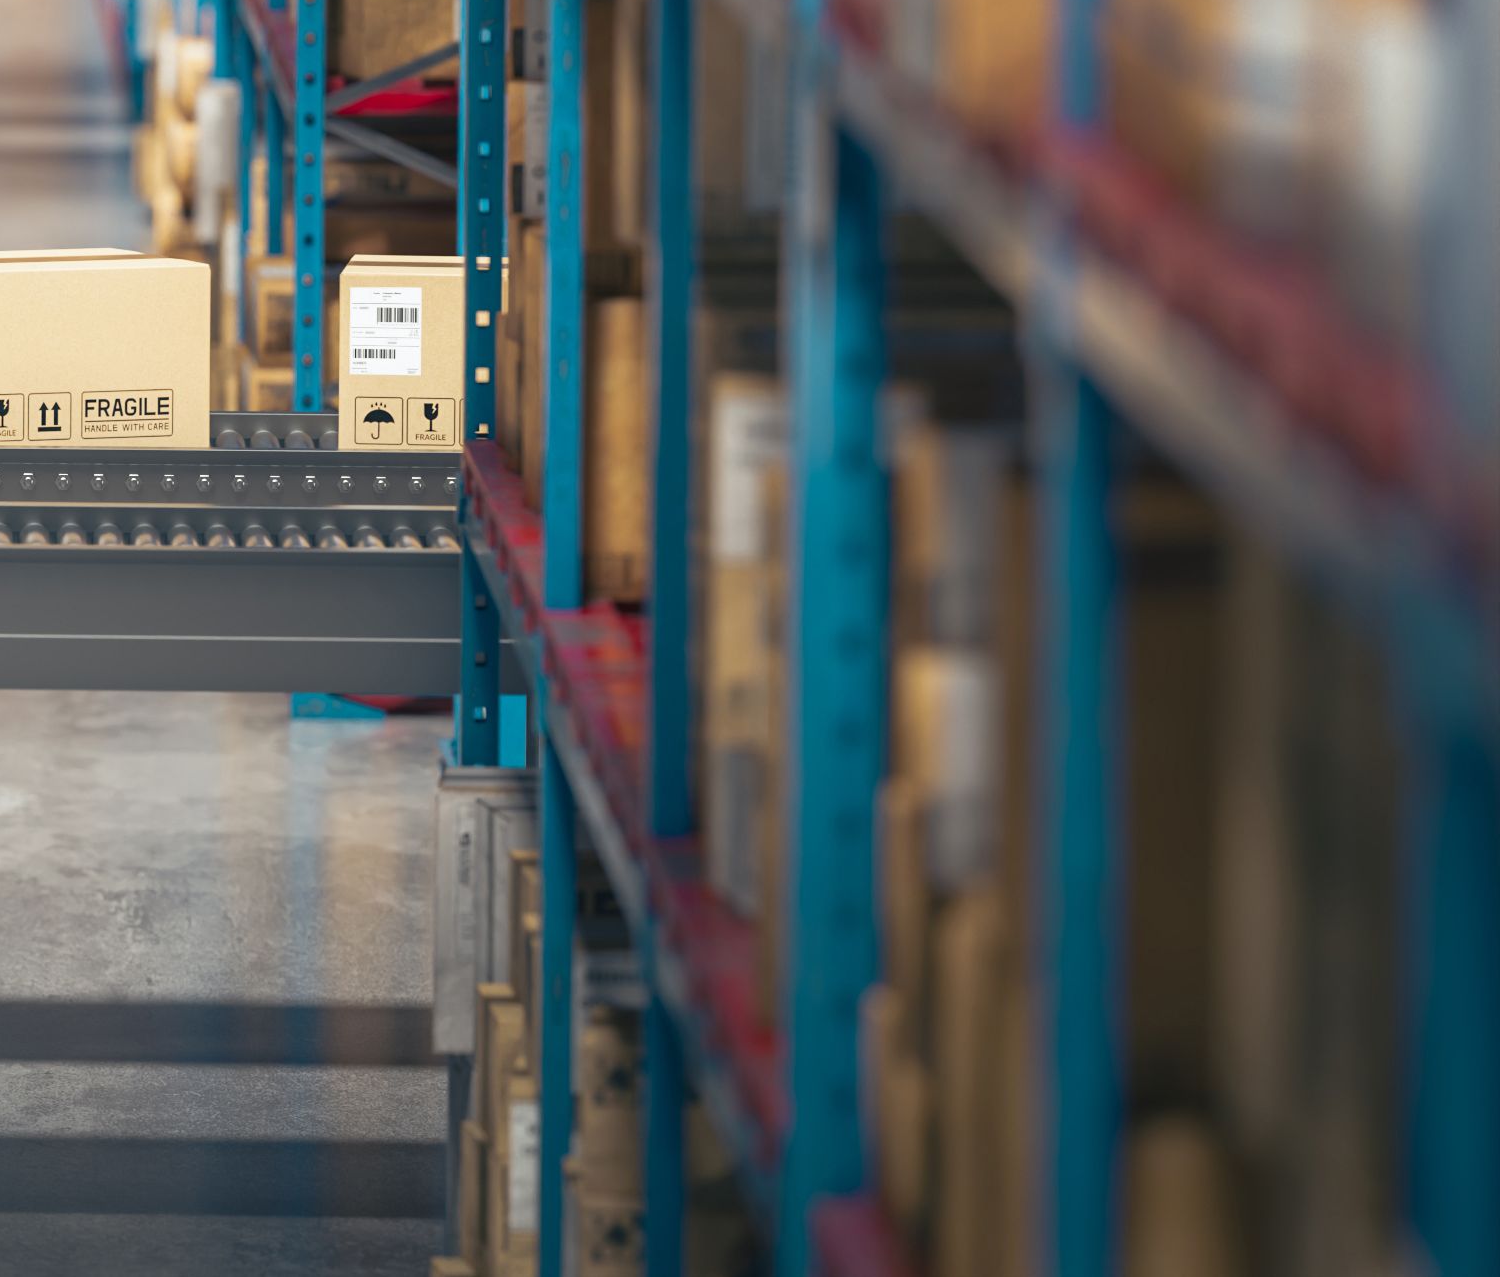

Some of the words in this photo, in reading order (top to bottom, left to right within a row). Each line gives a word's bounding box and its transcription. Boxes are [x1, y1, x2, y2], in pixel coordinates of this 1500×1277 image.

[84, 396, 170, 418] FRAGILE
[84, 424, 118, 433] HANDLE
[122, 423, 145, 432] WITH
[147, 422, 170, 431] CARE
[415, 433, 446, 441] FRAGILE
